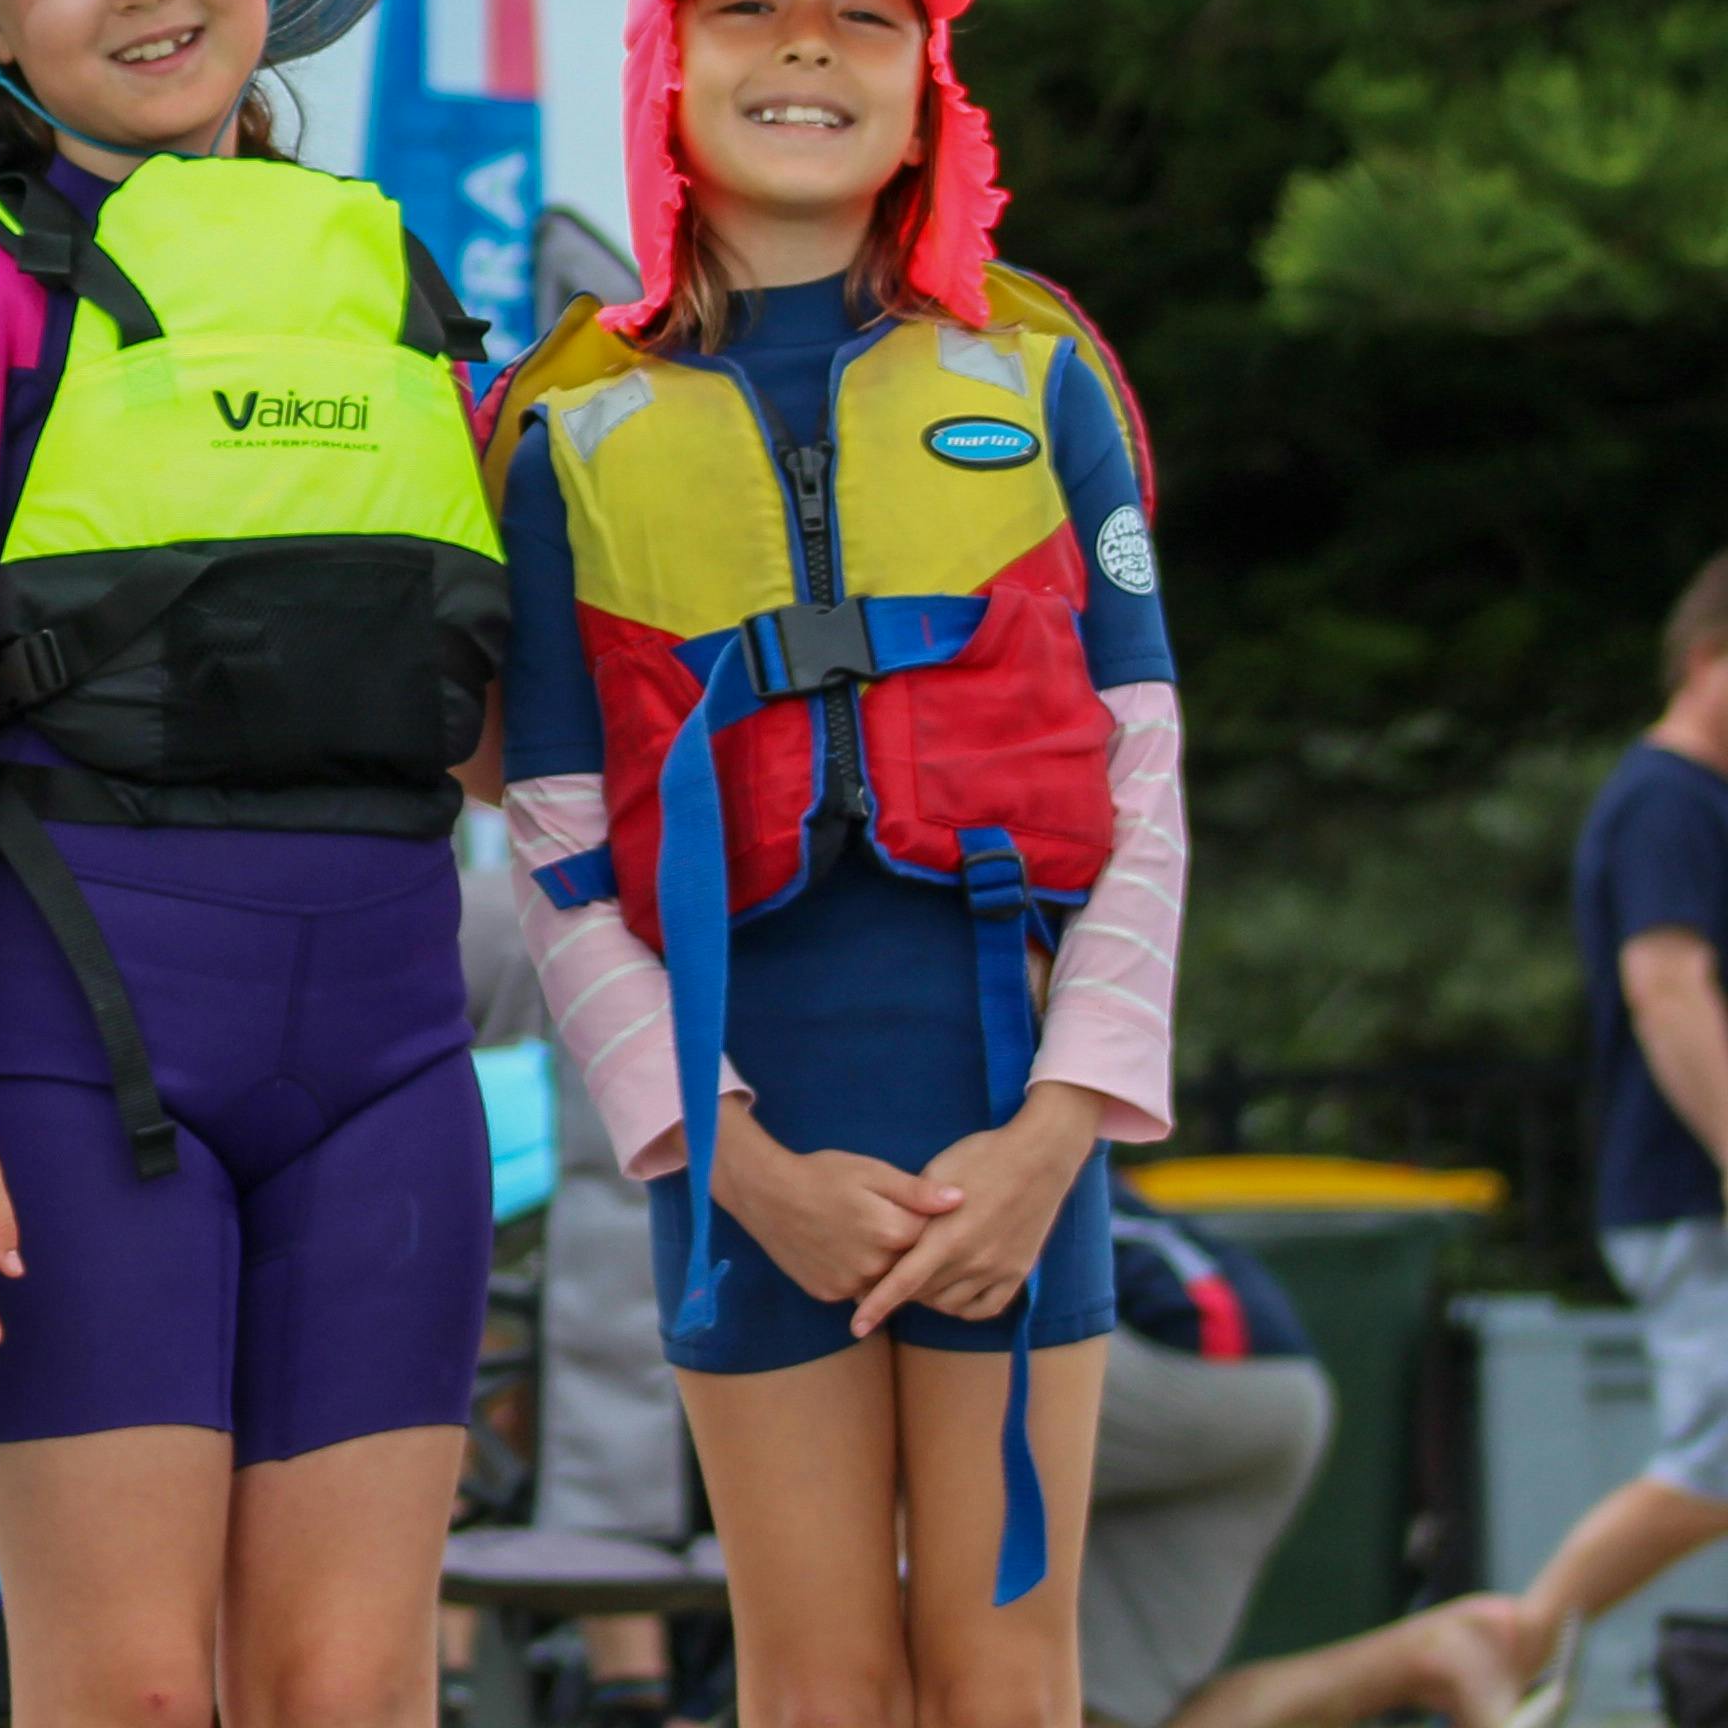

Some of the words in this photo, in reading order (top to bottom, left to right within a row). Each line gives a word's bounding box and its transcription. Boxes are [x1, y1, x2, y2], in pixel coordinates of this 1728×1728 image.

[212, 390, 369, 432] Vaikobi
[211, 439, 266, 449] OCEAN
[271, 439, 379, 452] PERFORMANCE
